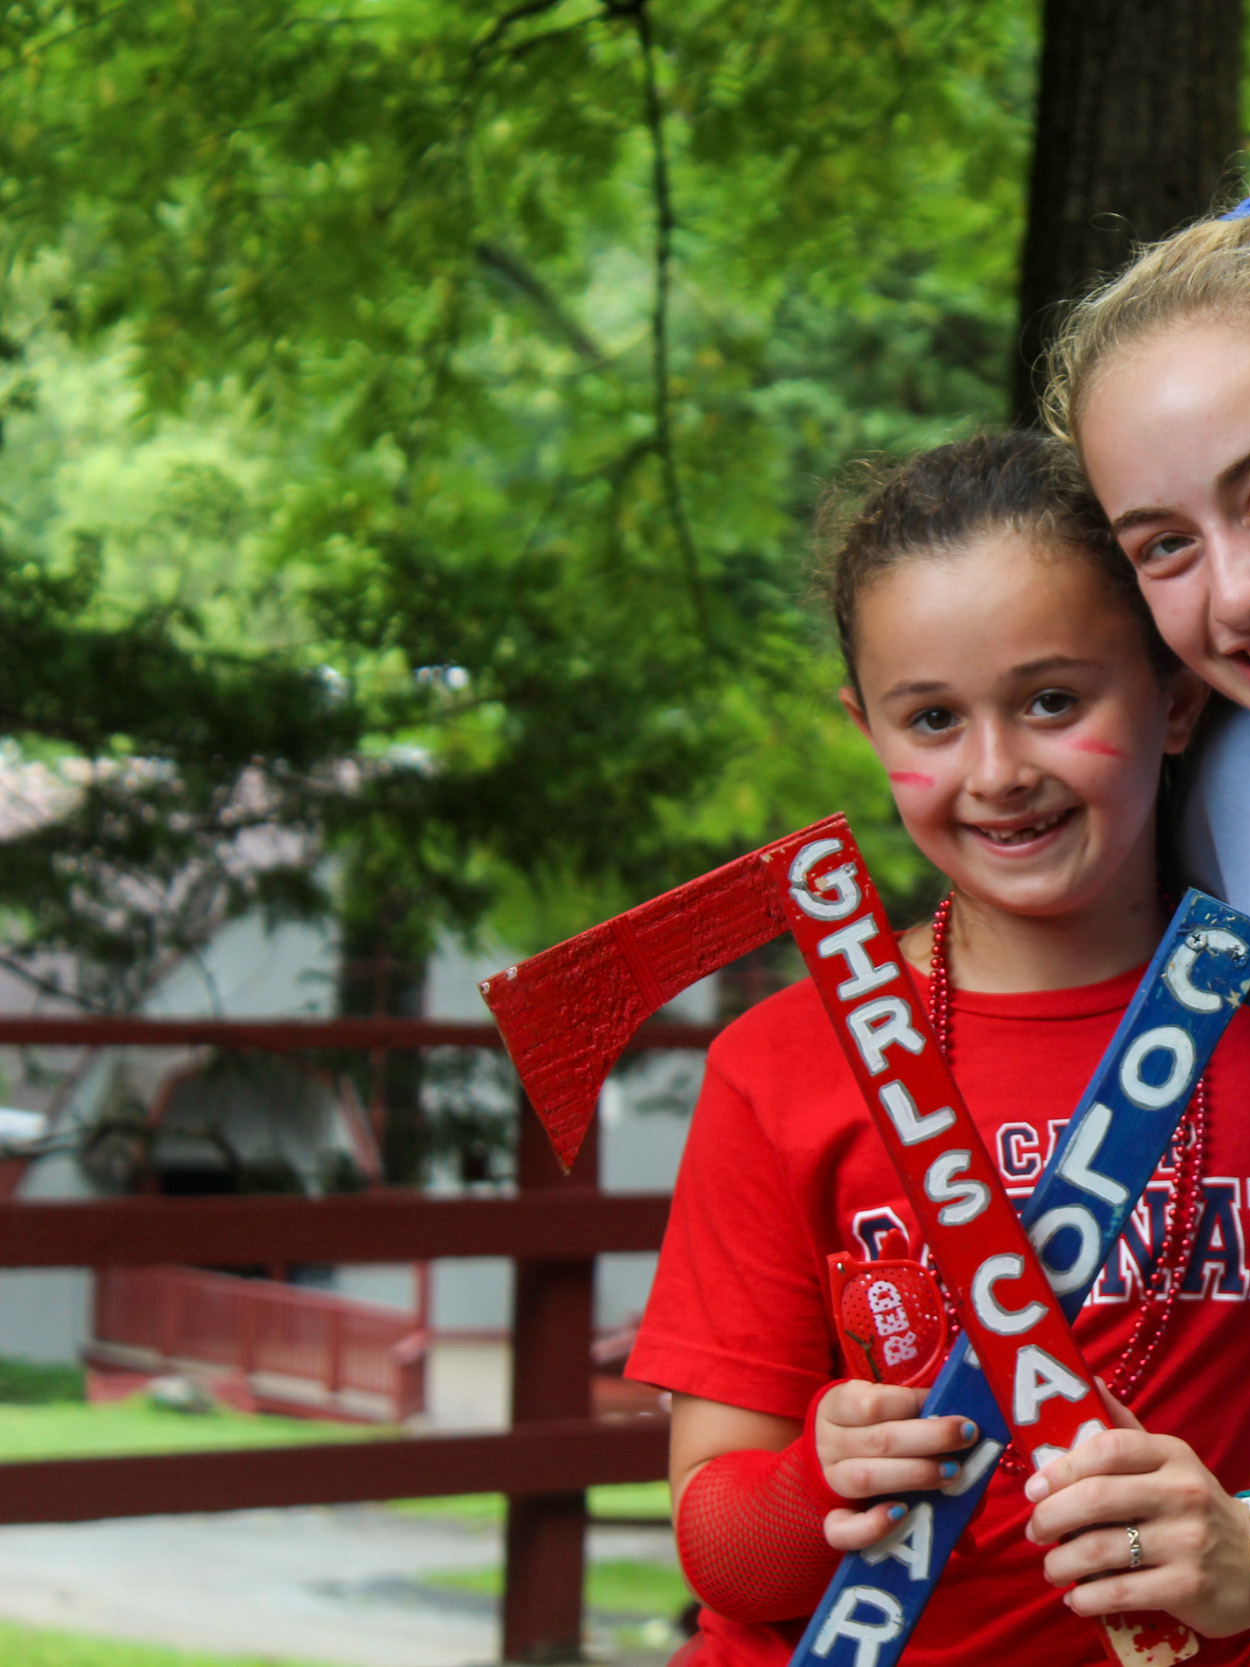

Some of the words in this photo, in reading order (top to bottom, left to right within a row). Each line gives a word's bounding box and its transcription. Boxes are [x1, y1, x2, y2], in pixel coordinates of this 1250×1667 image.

[787, 837, 991, 1226] GIRLS
[964, 928, 1249, 1370] COLO
[868, 1280, 918, 1366] RED
[811, 1413, 1003, 1667] AR
